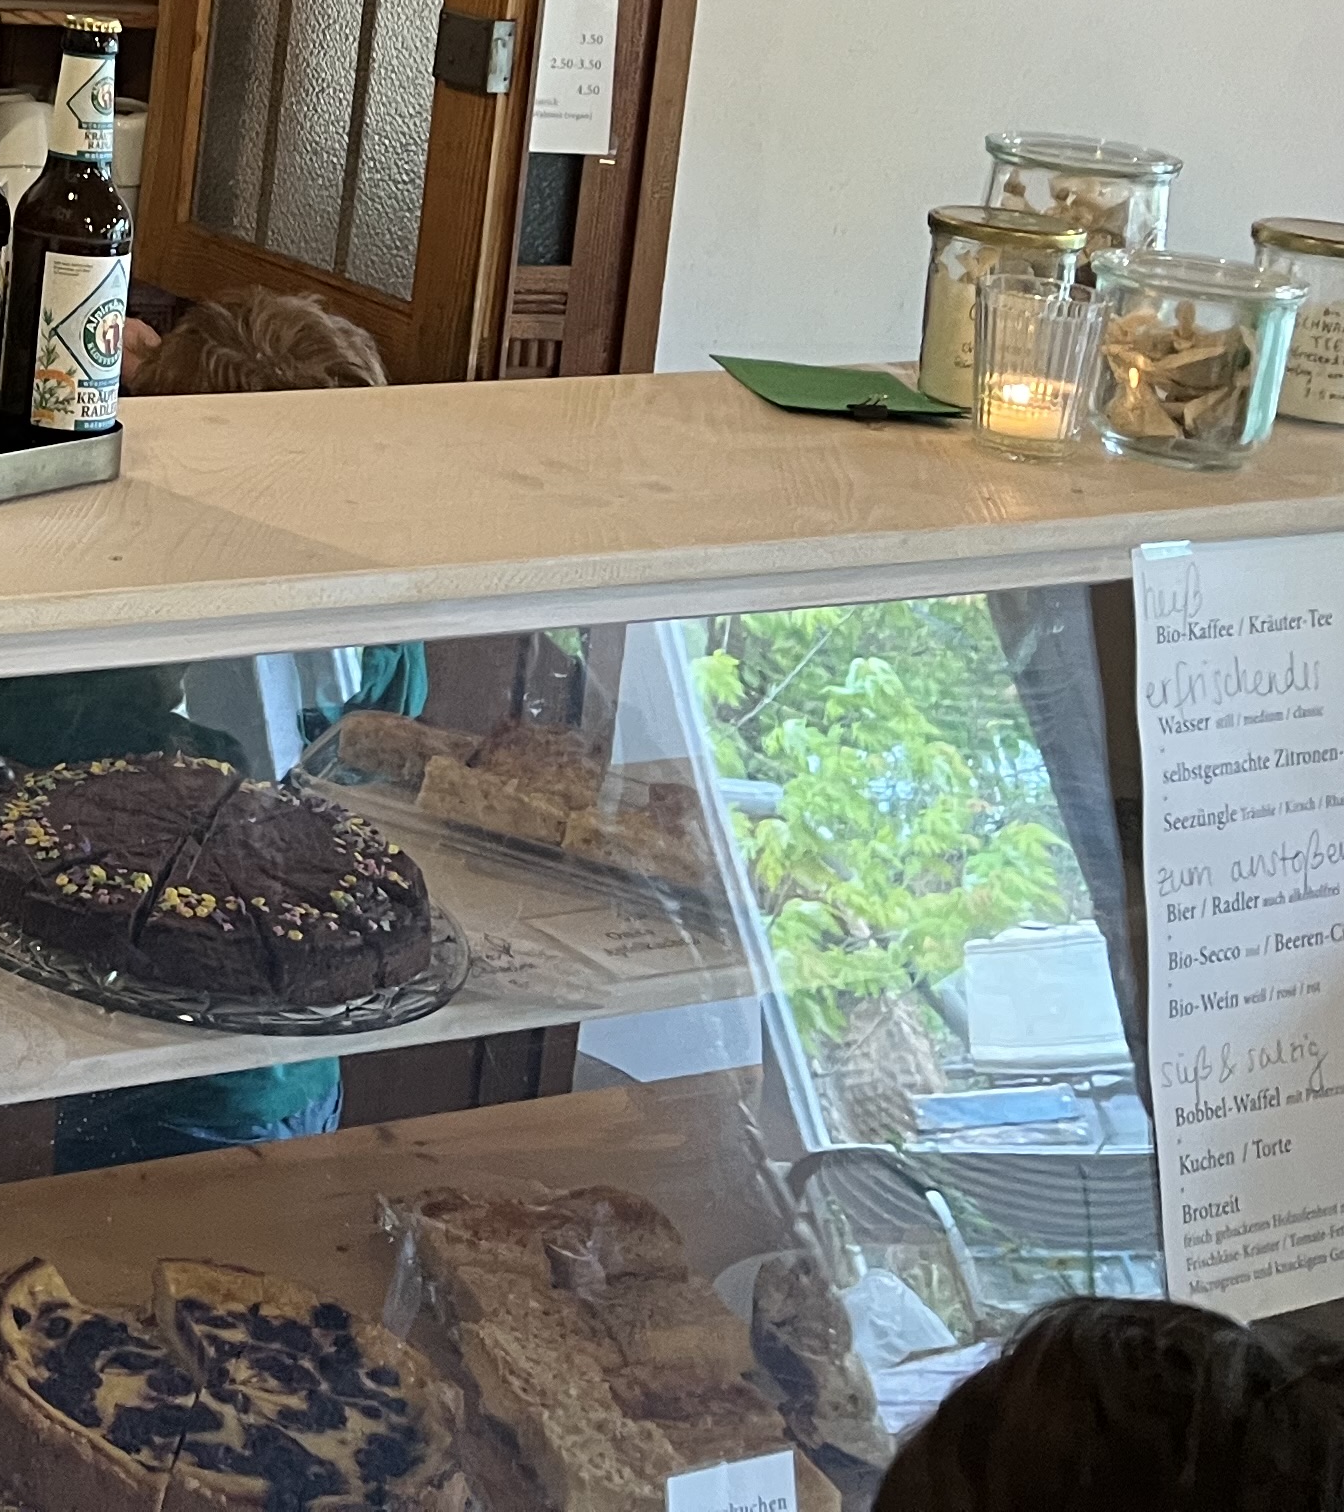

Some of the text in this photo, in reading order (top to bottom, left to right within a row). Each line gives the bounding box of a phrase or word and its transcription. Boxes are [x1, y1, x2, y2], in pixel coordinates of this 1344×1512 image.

[580, 34, 603, 45] 3.50
[576, 85, 600, 95] 4.50
[1156, 617, 1235, 645] Bio-Kaffee
[1248, 608, 1334, 635] Kräuter-Tee
[1158, 715, 1212, 736] Wasser
[1162, 746, 1344, 785] selbstgemachte Zitronen-
[1163, 802, 1238, 832] Seezüngle
[1157, 866, 1213, 898] zum
[1166, 902, 1197, 924] Bier
[1212, 890, 1261, 917] Radler
[1167, 945, 1241, 971] Bio-Secco
[1168, 990, 1240, 1019] Bio-Wein
[1174, 1085, 1281, 1127] Bobbel-Waffel
[1178, 1148, 1235, 1176] Kuchen
[1251, 1138, 1293, 1160] Torte
[1181, 1194, 1241, 1225] Brotzeit
